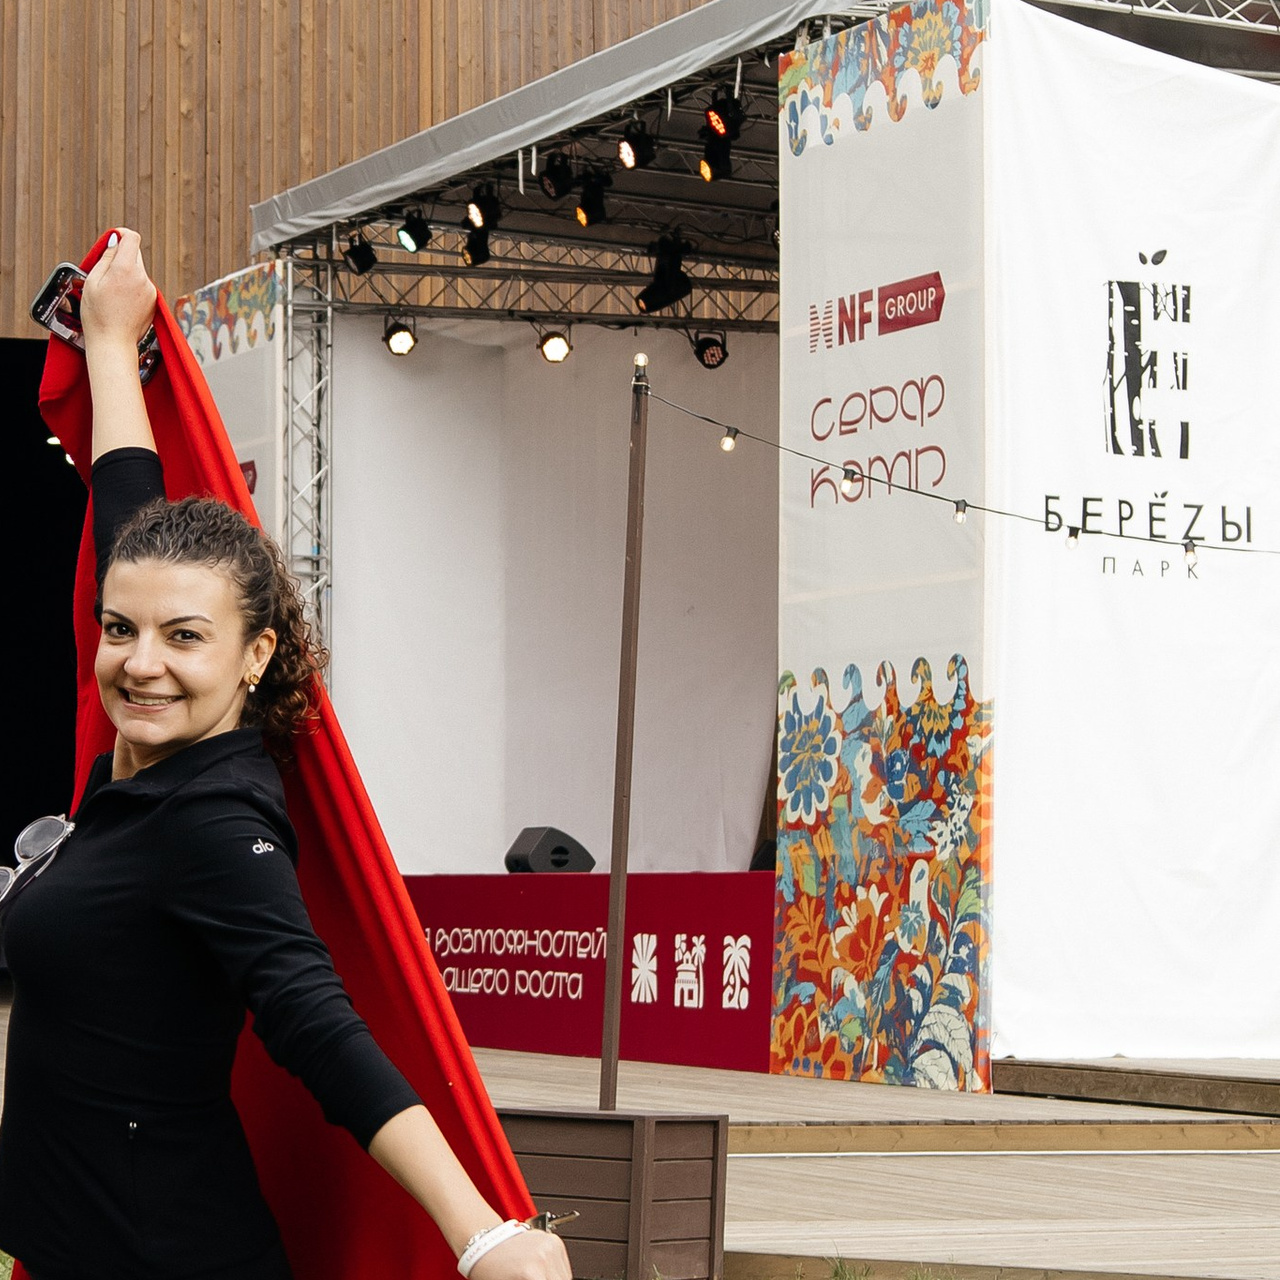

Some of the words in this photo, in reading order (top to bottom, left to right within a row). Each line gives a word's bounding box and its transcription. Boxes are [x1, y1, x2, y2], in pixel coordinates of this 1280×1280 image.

[884, 286, 937, 320] GROUP
[1102, 556, 1199, 580] ПАРК
[252, 837, 275, 855] alo
[441, 966, 511, 997] ашего
[514, 969, 584, 1001] роста
